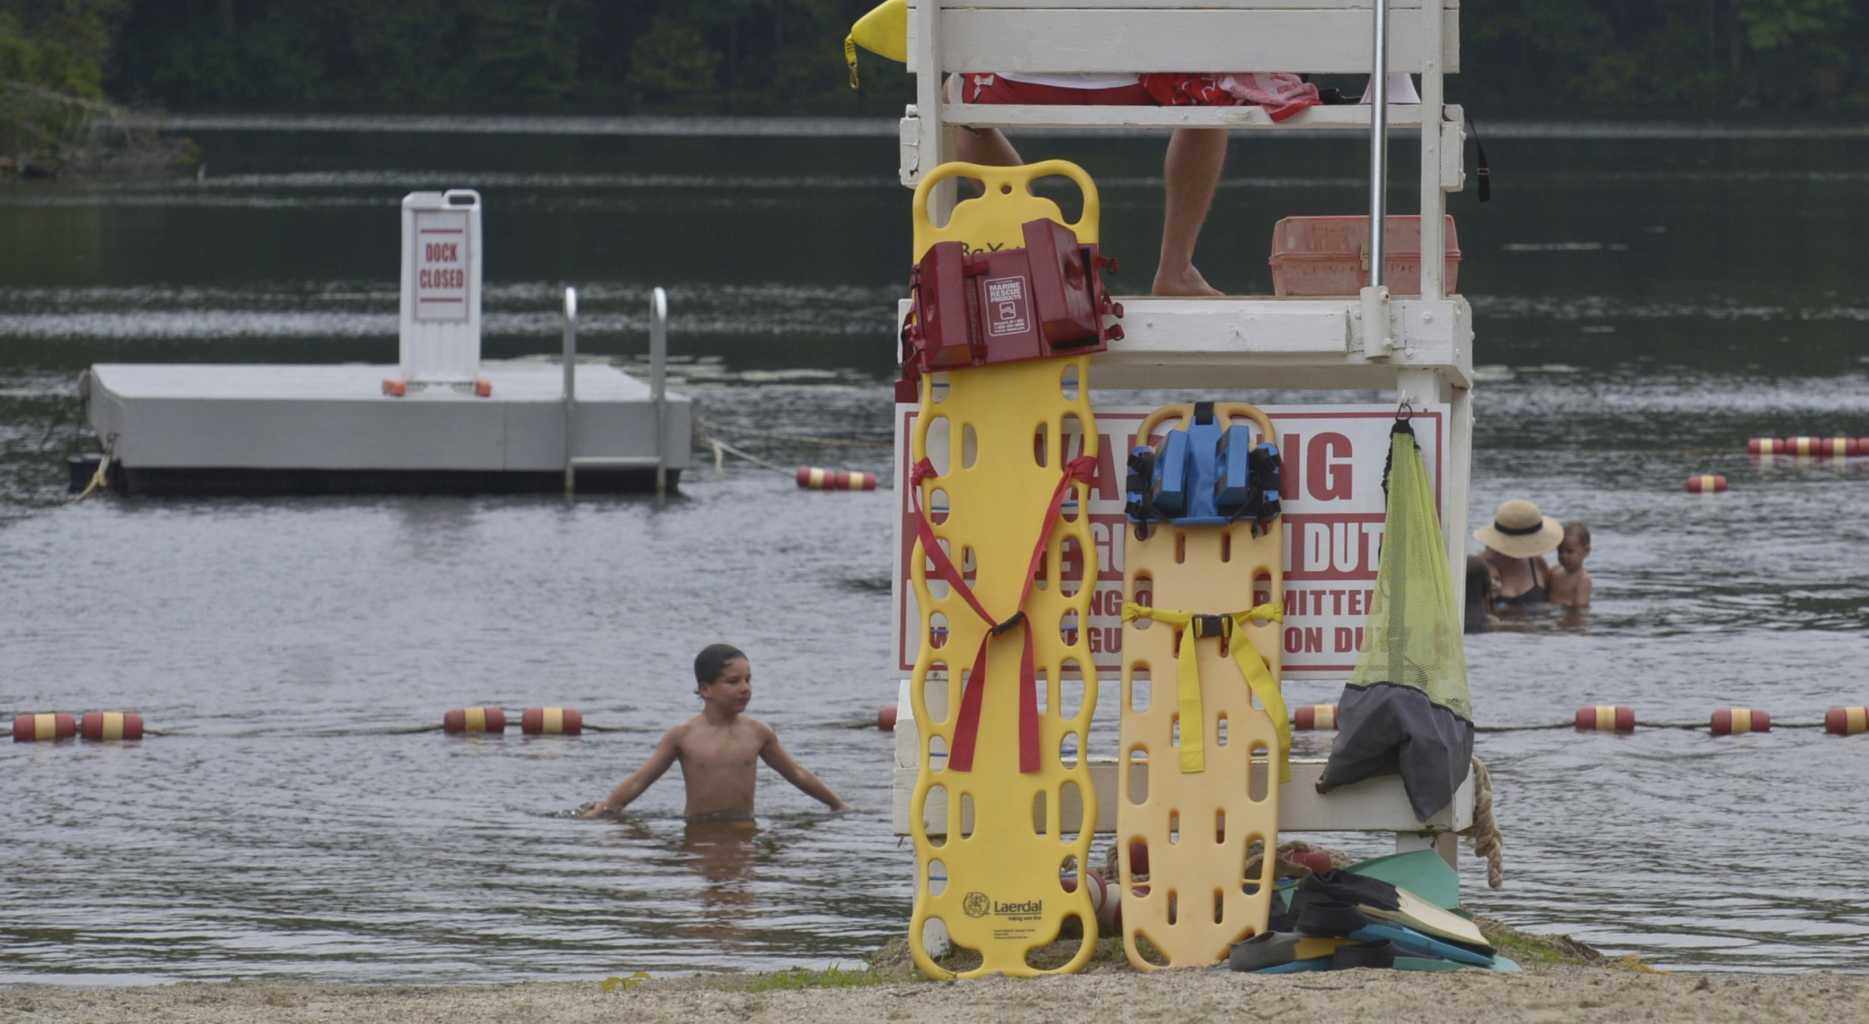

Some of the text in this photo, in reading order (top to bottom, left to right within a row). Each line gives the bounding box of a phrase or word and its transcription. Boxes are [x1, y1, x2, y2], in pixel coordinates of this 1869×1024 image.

[425, 243, 457, 262] DOCK
[420, 269, 464, 289] CLOSED
[1303, 522, 1386, 572] DUT
[1284, 626, 1323, 653] ON
[994, 900, 1042, 913] Laerdal
